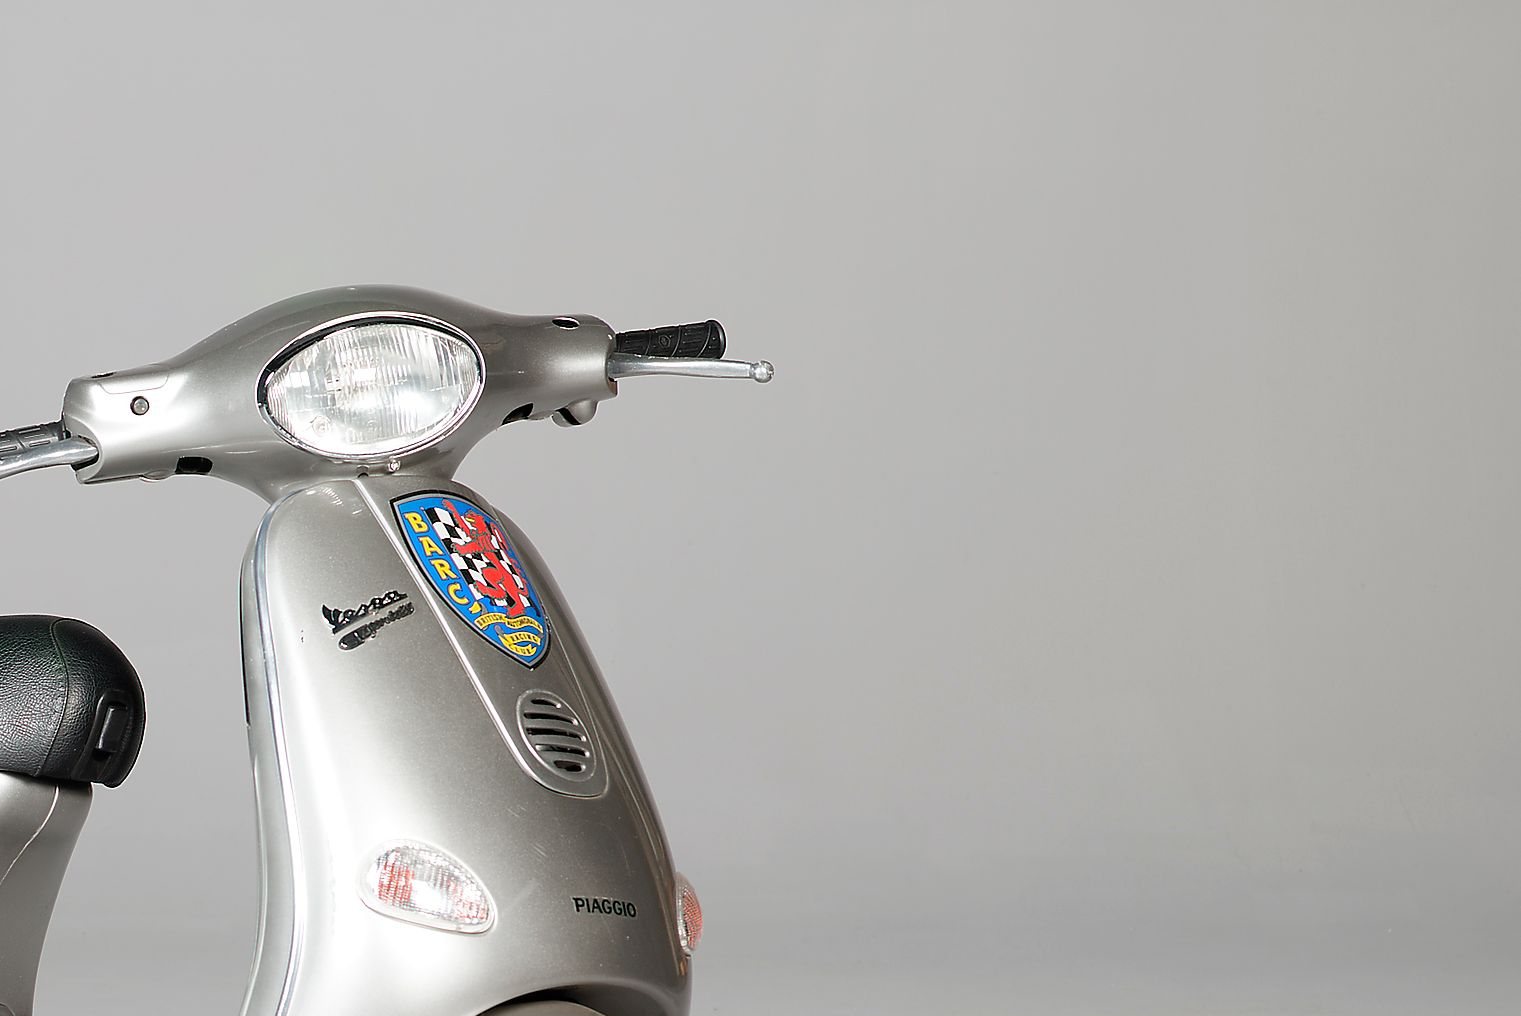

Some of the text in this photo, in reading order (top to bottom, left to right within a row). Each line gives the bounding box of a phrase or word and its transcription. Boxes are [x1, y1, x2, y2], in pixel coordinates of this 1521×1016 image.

[403, 511, 470, 605] BARC
[321, 590, 408, 634] Vespa
[572, 897, 637, 918] PIAGGIO
